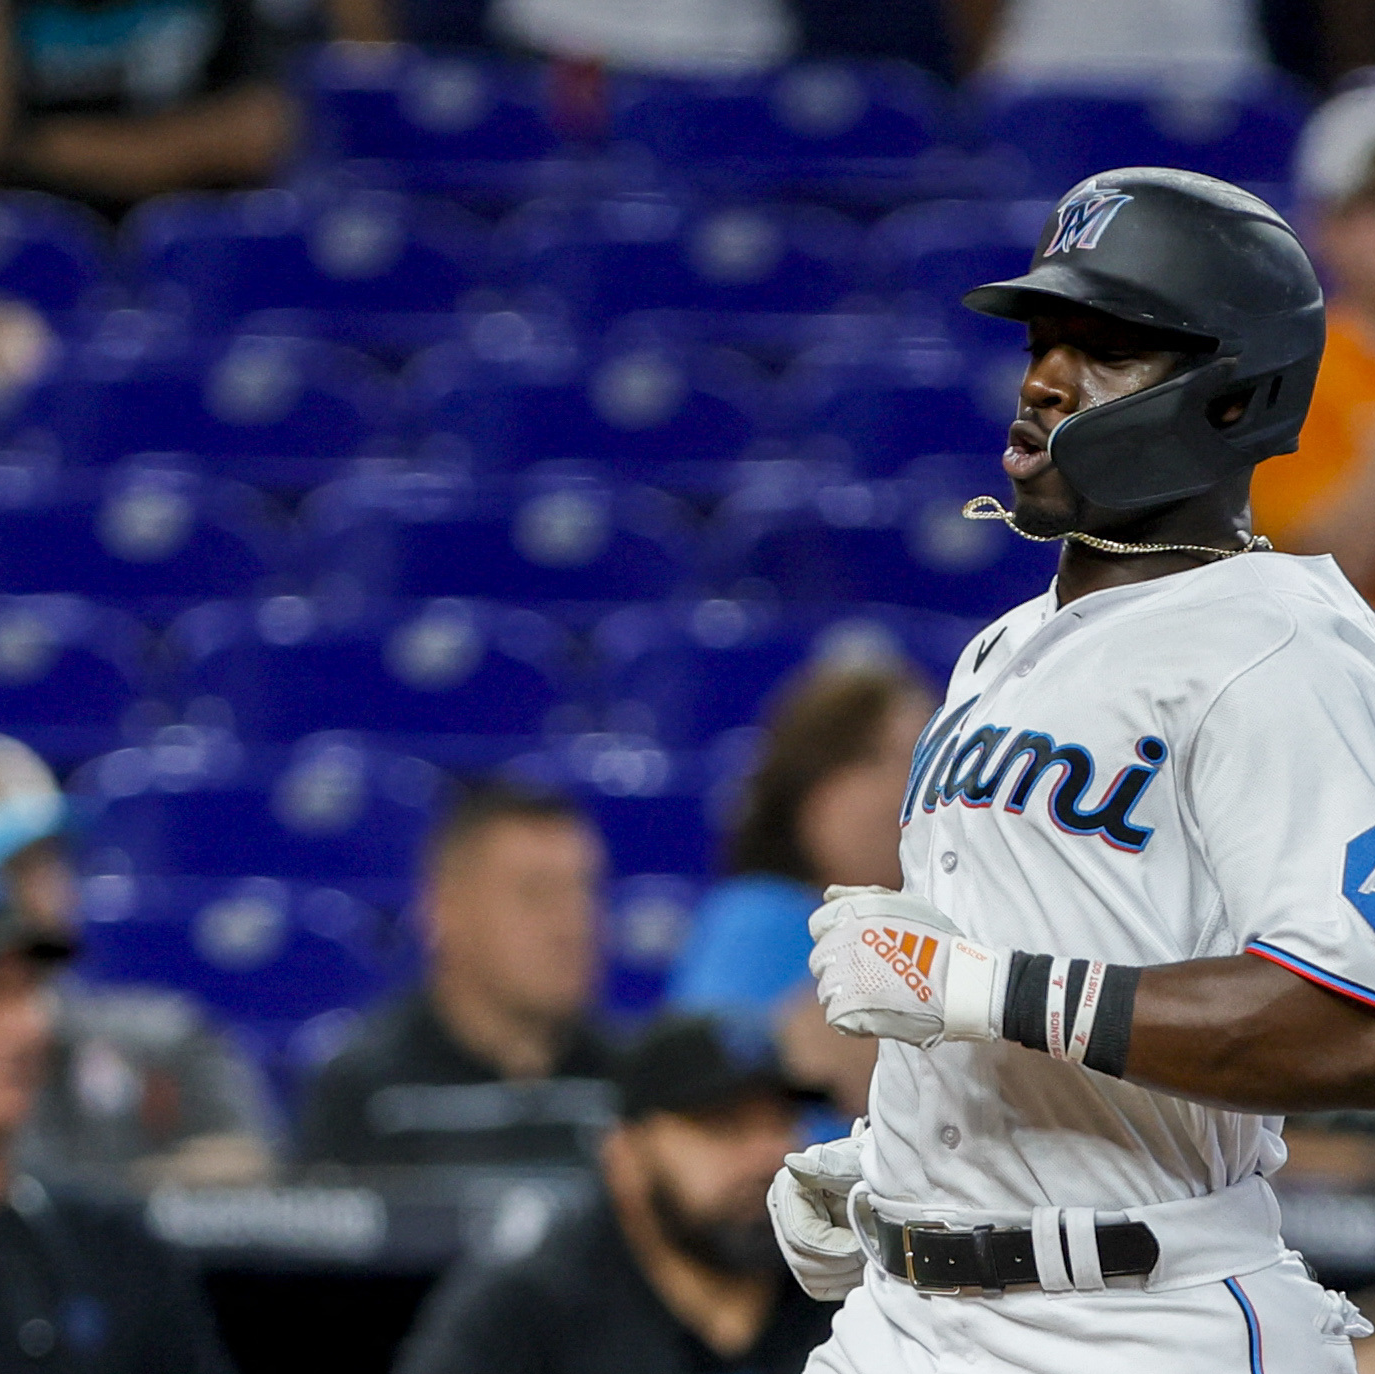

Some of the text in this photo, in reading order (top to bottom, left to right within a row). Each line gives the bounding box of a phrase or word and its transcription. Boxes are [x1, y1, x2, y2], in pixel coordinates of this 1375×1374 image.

[899, 693, 1169, 854] Miami
[861, 928, 933, 1003] adidas
[1083, 976, 1098, 1009] TRUST
